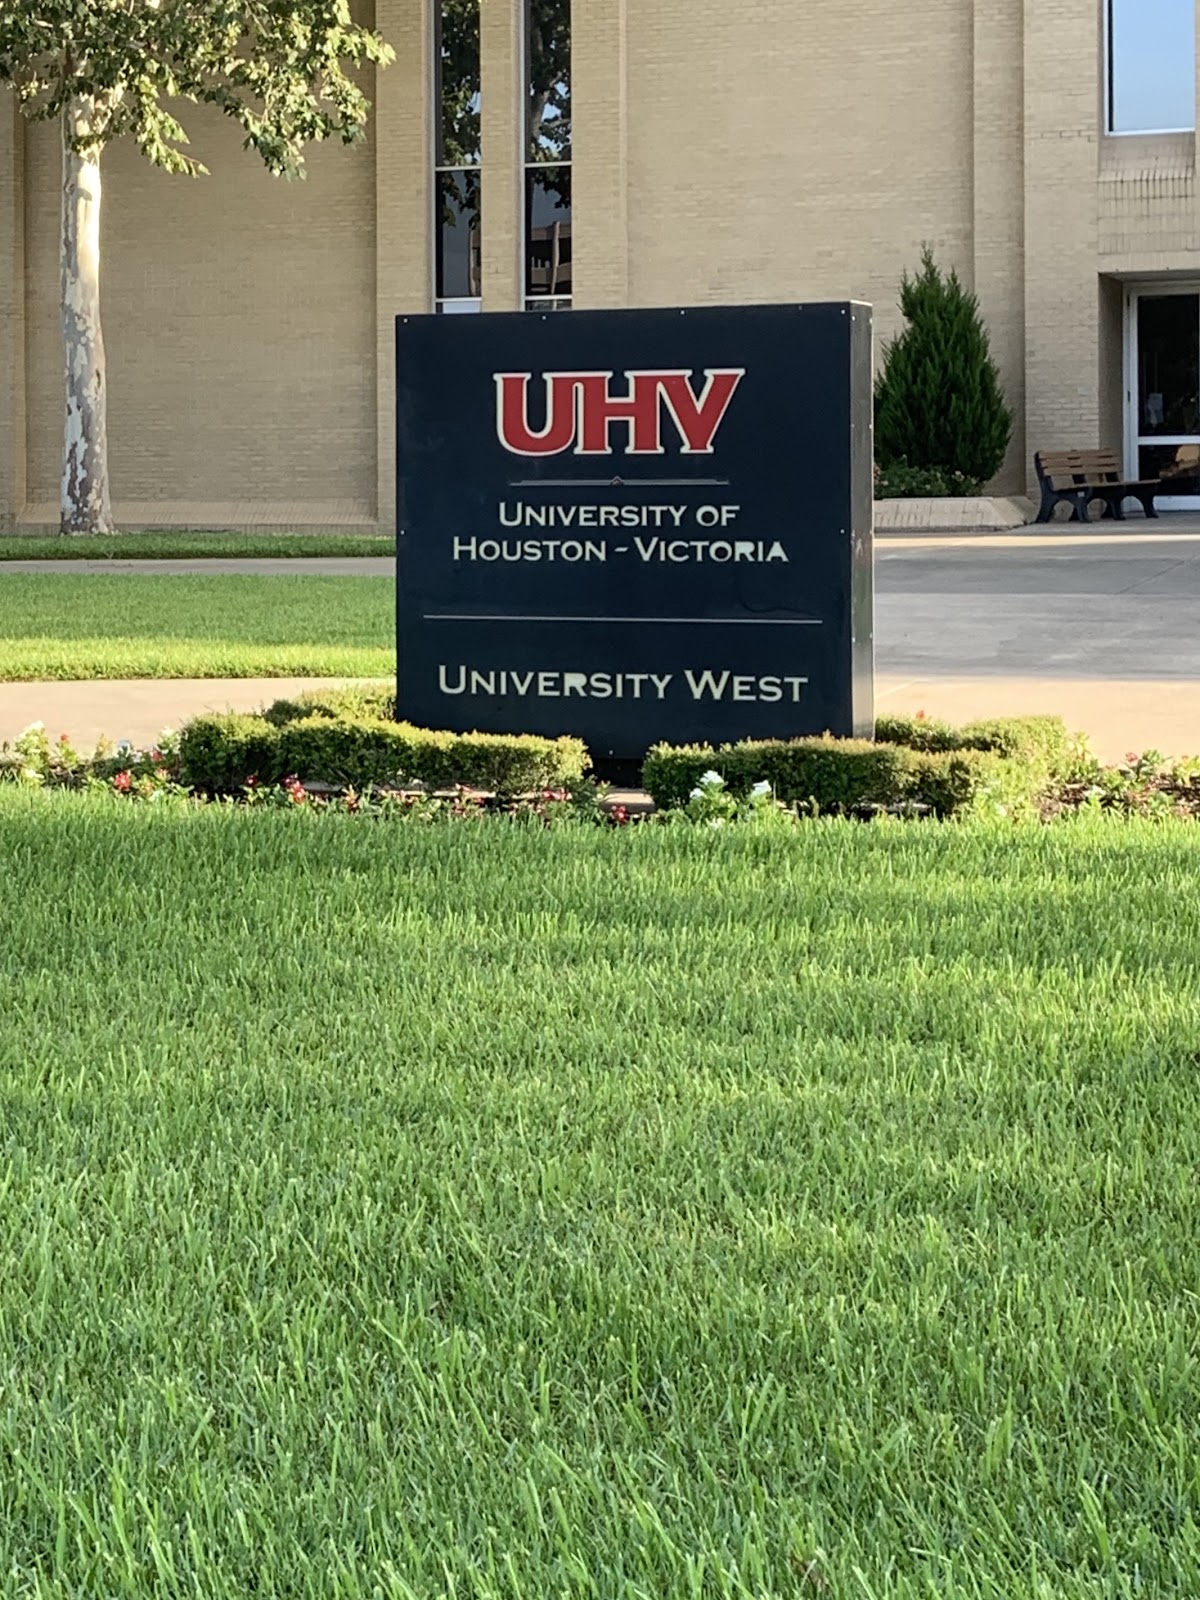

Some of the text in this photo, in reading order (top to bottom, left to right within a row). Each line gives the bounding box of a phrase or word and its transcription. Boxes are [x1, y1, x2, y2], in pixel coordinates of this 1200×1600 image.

[493, 368, 745, 456] UHV
[500, 502, 740, 526] UNIVERSITY OF
[454, 536, 605, 561] HOUSTON
[634, 537, 788, 561] VICTORIA
[440, 665, 808, 701] UNIVERSITY WEST
